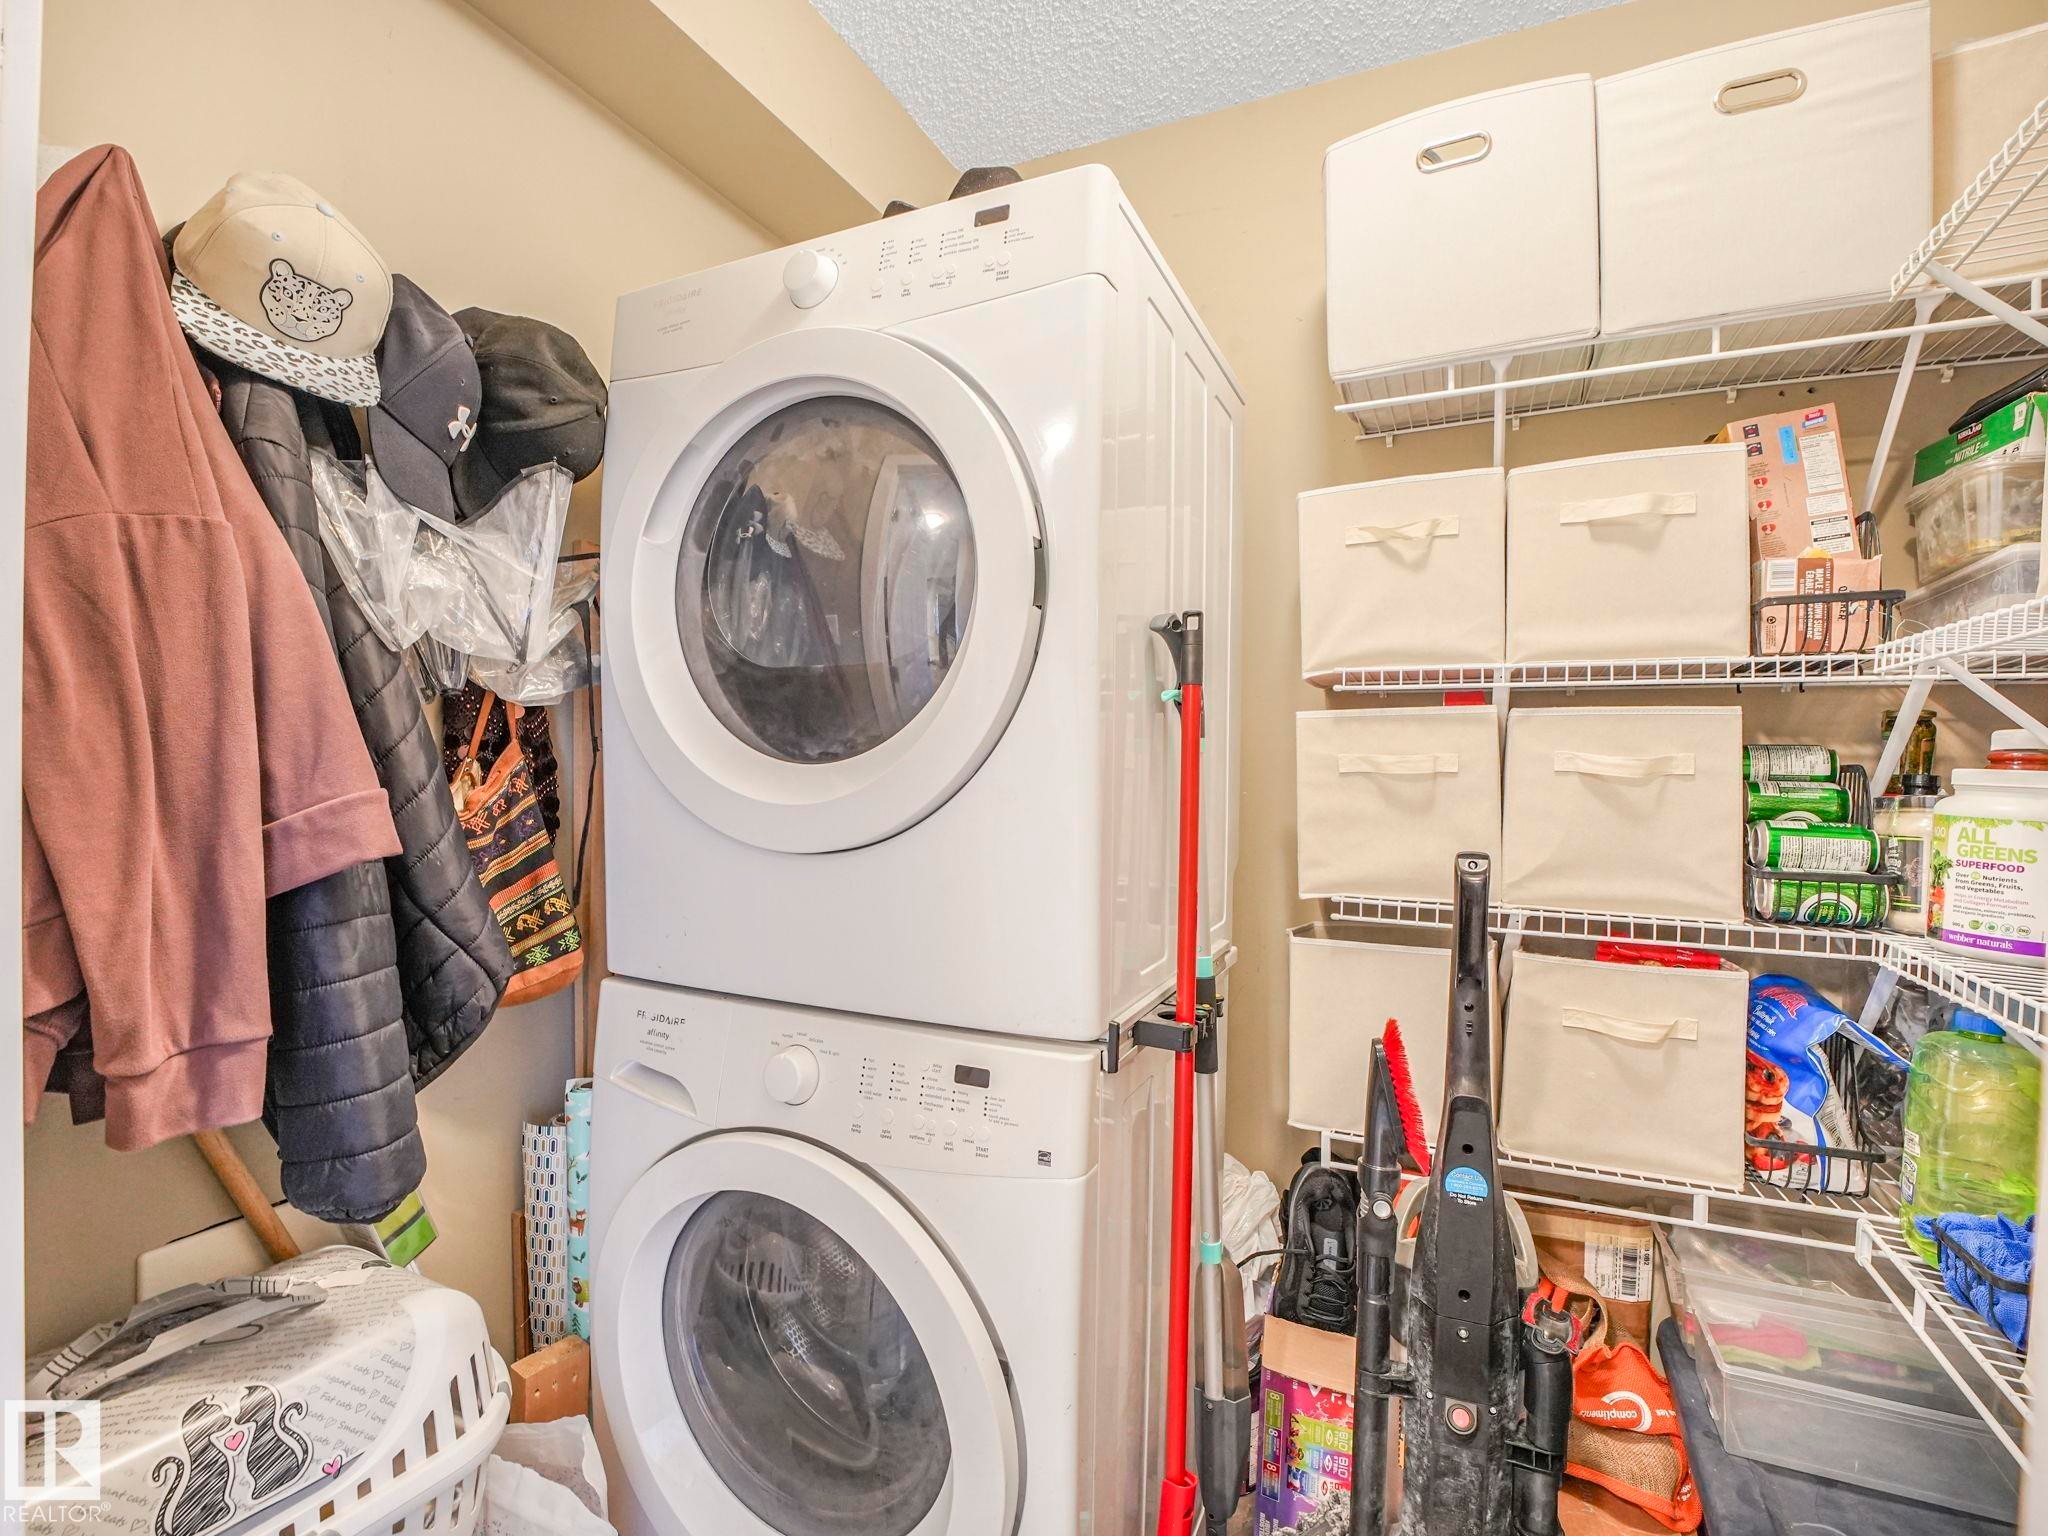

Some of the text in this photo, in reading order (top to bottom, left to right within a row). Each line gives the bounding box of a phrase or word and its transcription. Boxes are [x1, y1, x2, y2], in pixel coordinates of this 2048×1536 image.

[1815, 568, 1824, 591] MAPLE
[1813, 620, 1823, 640] SUGAR
[1957, 827, 1997, 845] ALL
[1957, 844, 2038, 864] GREENS
[1956, 859, 2025, 873] SUPERFOOD
[1971, 880, 1997, 889] Greens,
[1999, 883, 2024, 891] Fruits,
[1982, 875, 2018, 884] Nutrients
[1967, 885, 2005, 895] Vegetables
[1948, 932, 2013, 950] webber naturals
[1467, 1194, 1484, 1202] Return
[353, 1364, 370, 1376] cats
[350, 1384, 367, 1396] cats
[1270, 1392, 1280, 1401] 8
[320, 1391, 336, 1402] Fat
[336, 1400, 352, 1411] cats
[371, 1413, 387, 1425] love
[1580, 1409, 1638, 1421] compliments
[337, 1420, 364, 1438] Smart
[1268, 1428, 1279, 1437] 8
[1339, 1431, 1349, 1451] BIO
[1266, 1463, 1277, 1472] 8
[1338, 1456, 1349, 1478] BIO
